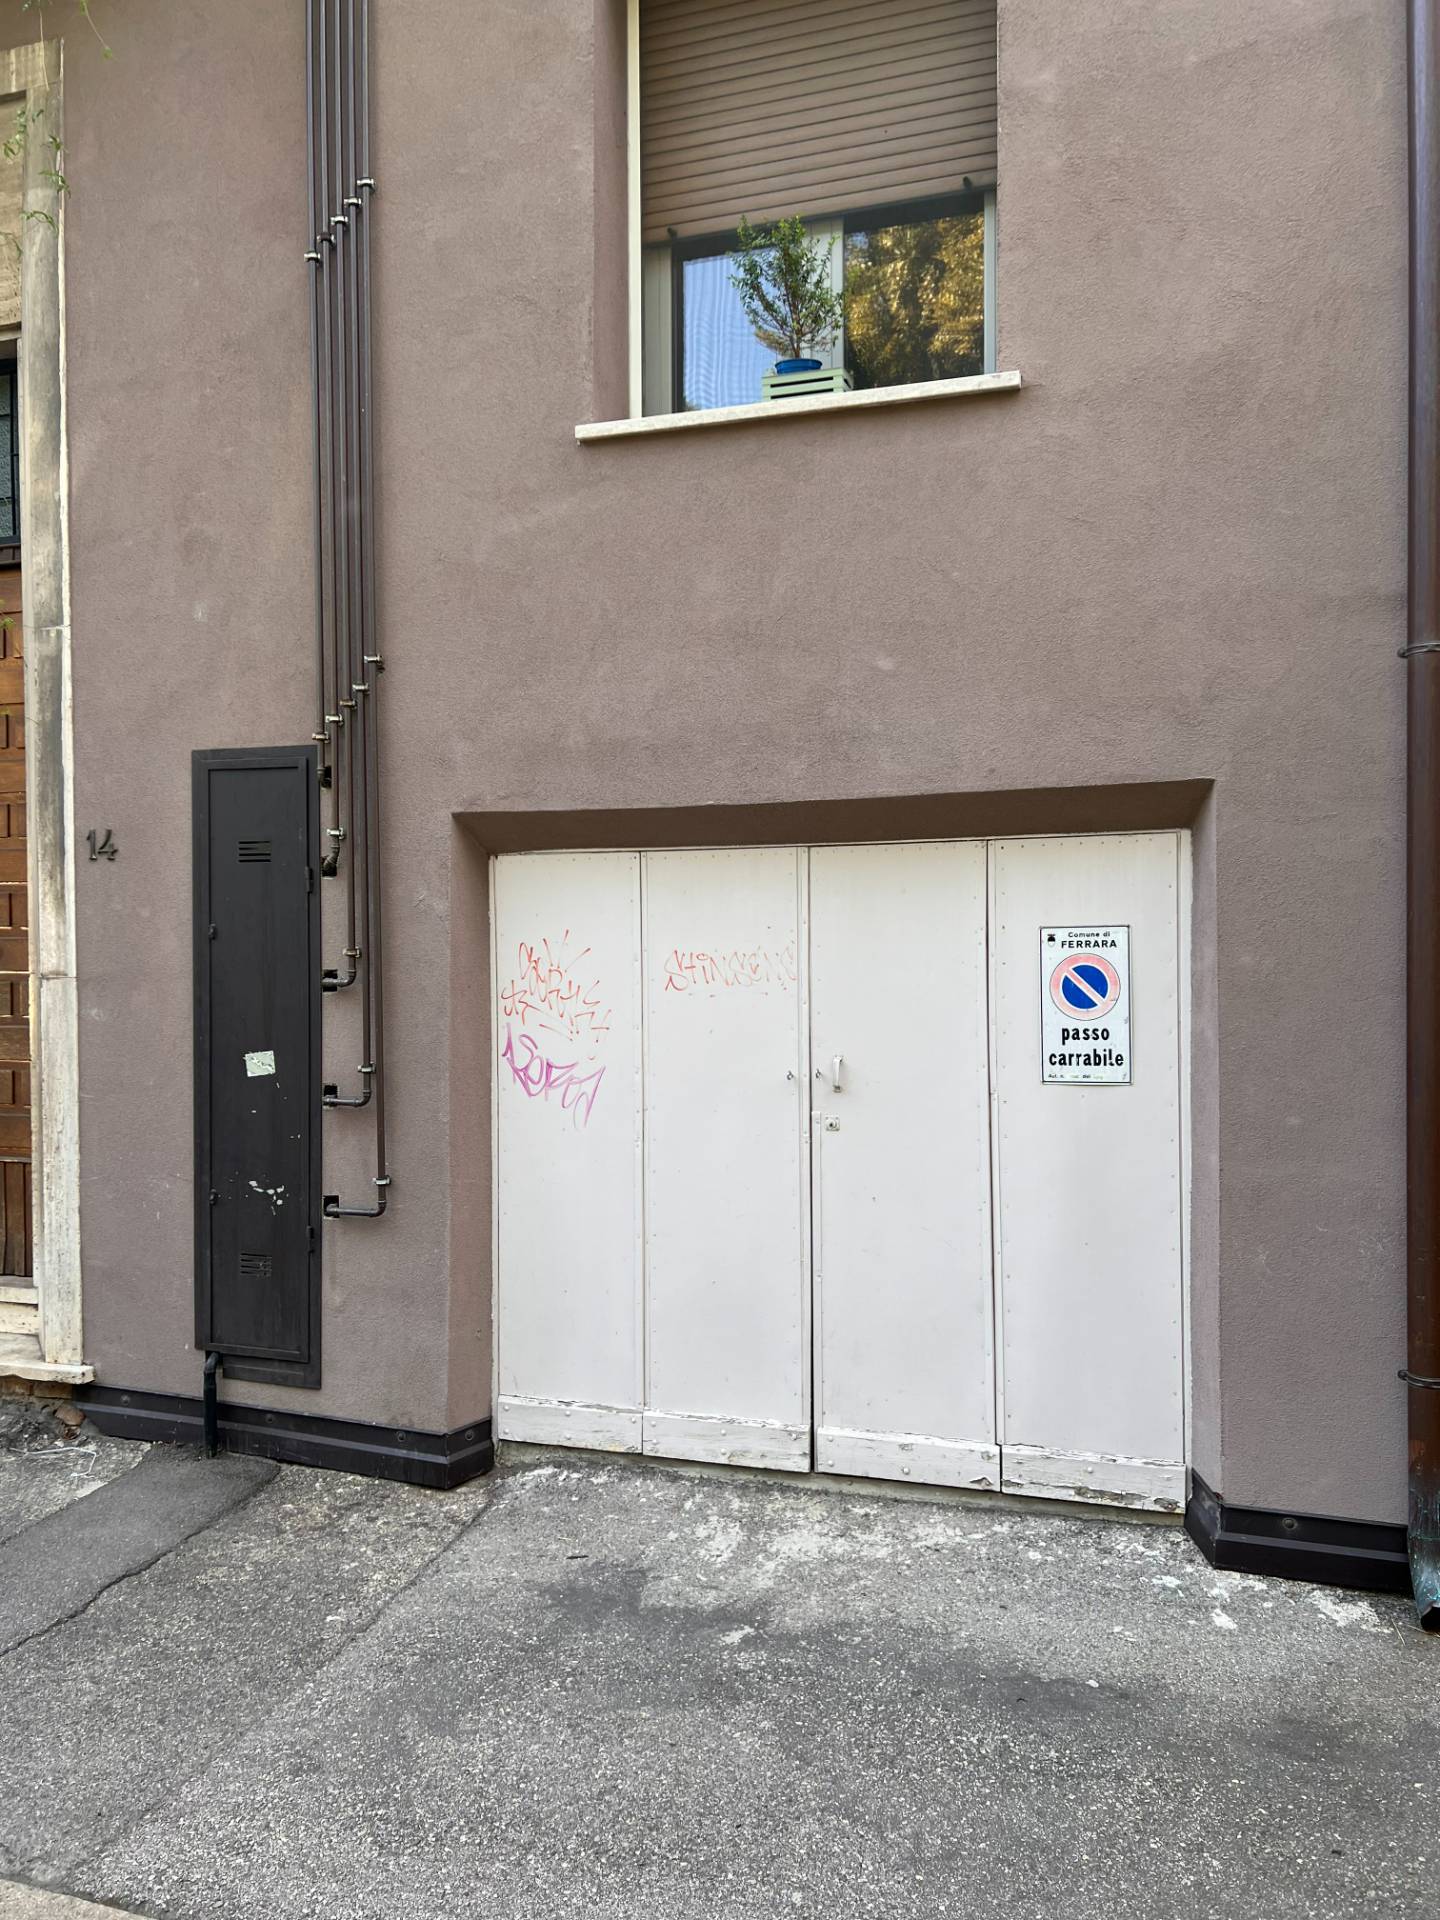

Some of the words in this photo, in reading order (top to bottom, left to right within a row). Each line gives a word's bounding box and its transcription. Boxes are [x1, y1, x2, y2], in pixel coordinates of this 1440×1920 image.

[86, 829, 118, 861] 14
[1061, 940, 1117, 949] FERRARA
[1062, 1027, 1110, 1045] passo
[1049, 1049, 1124, 1067] carrabile
